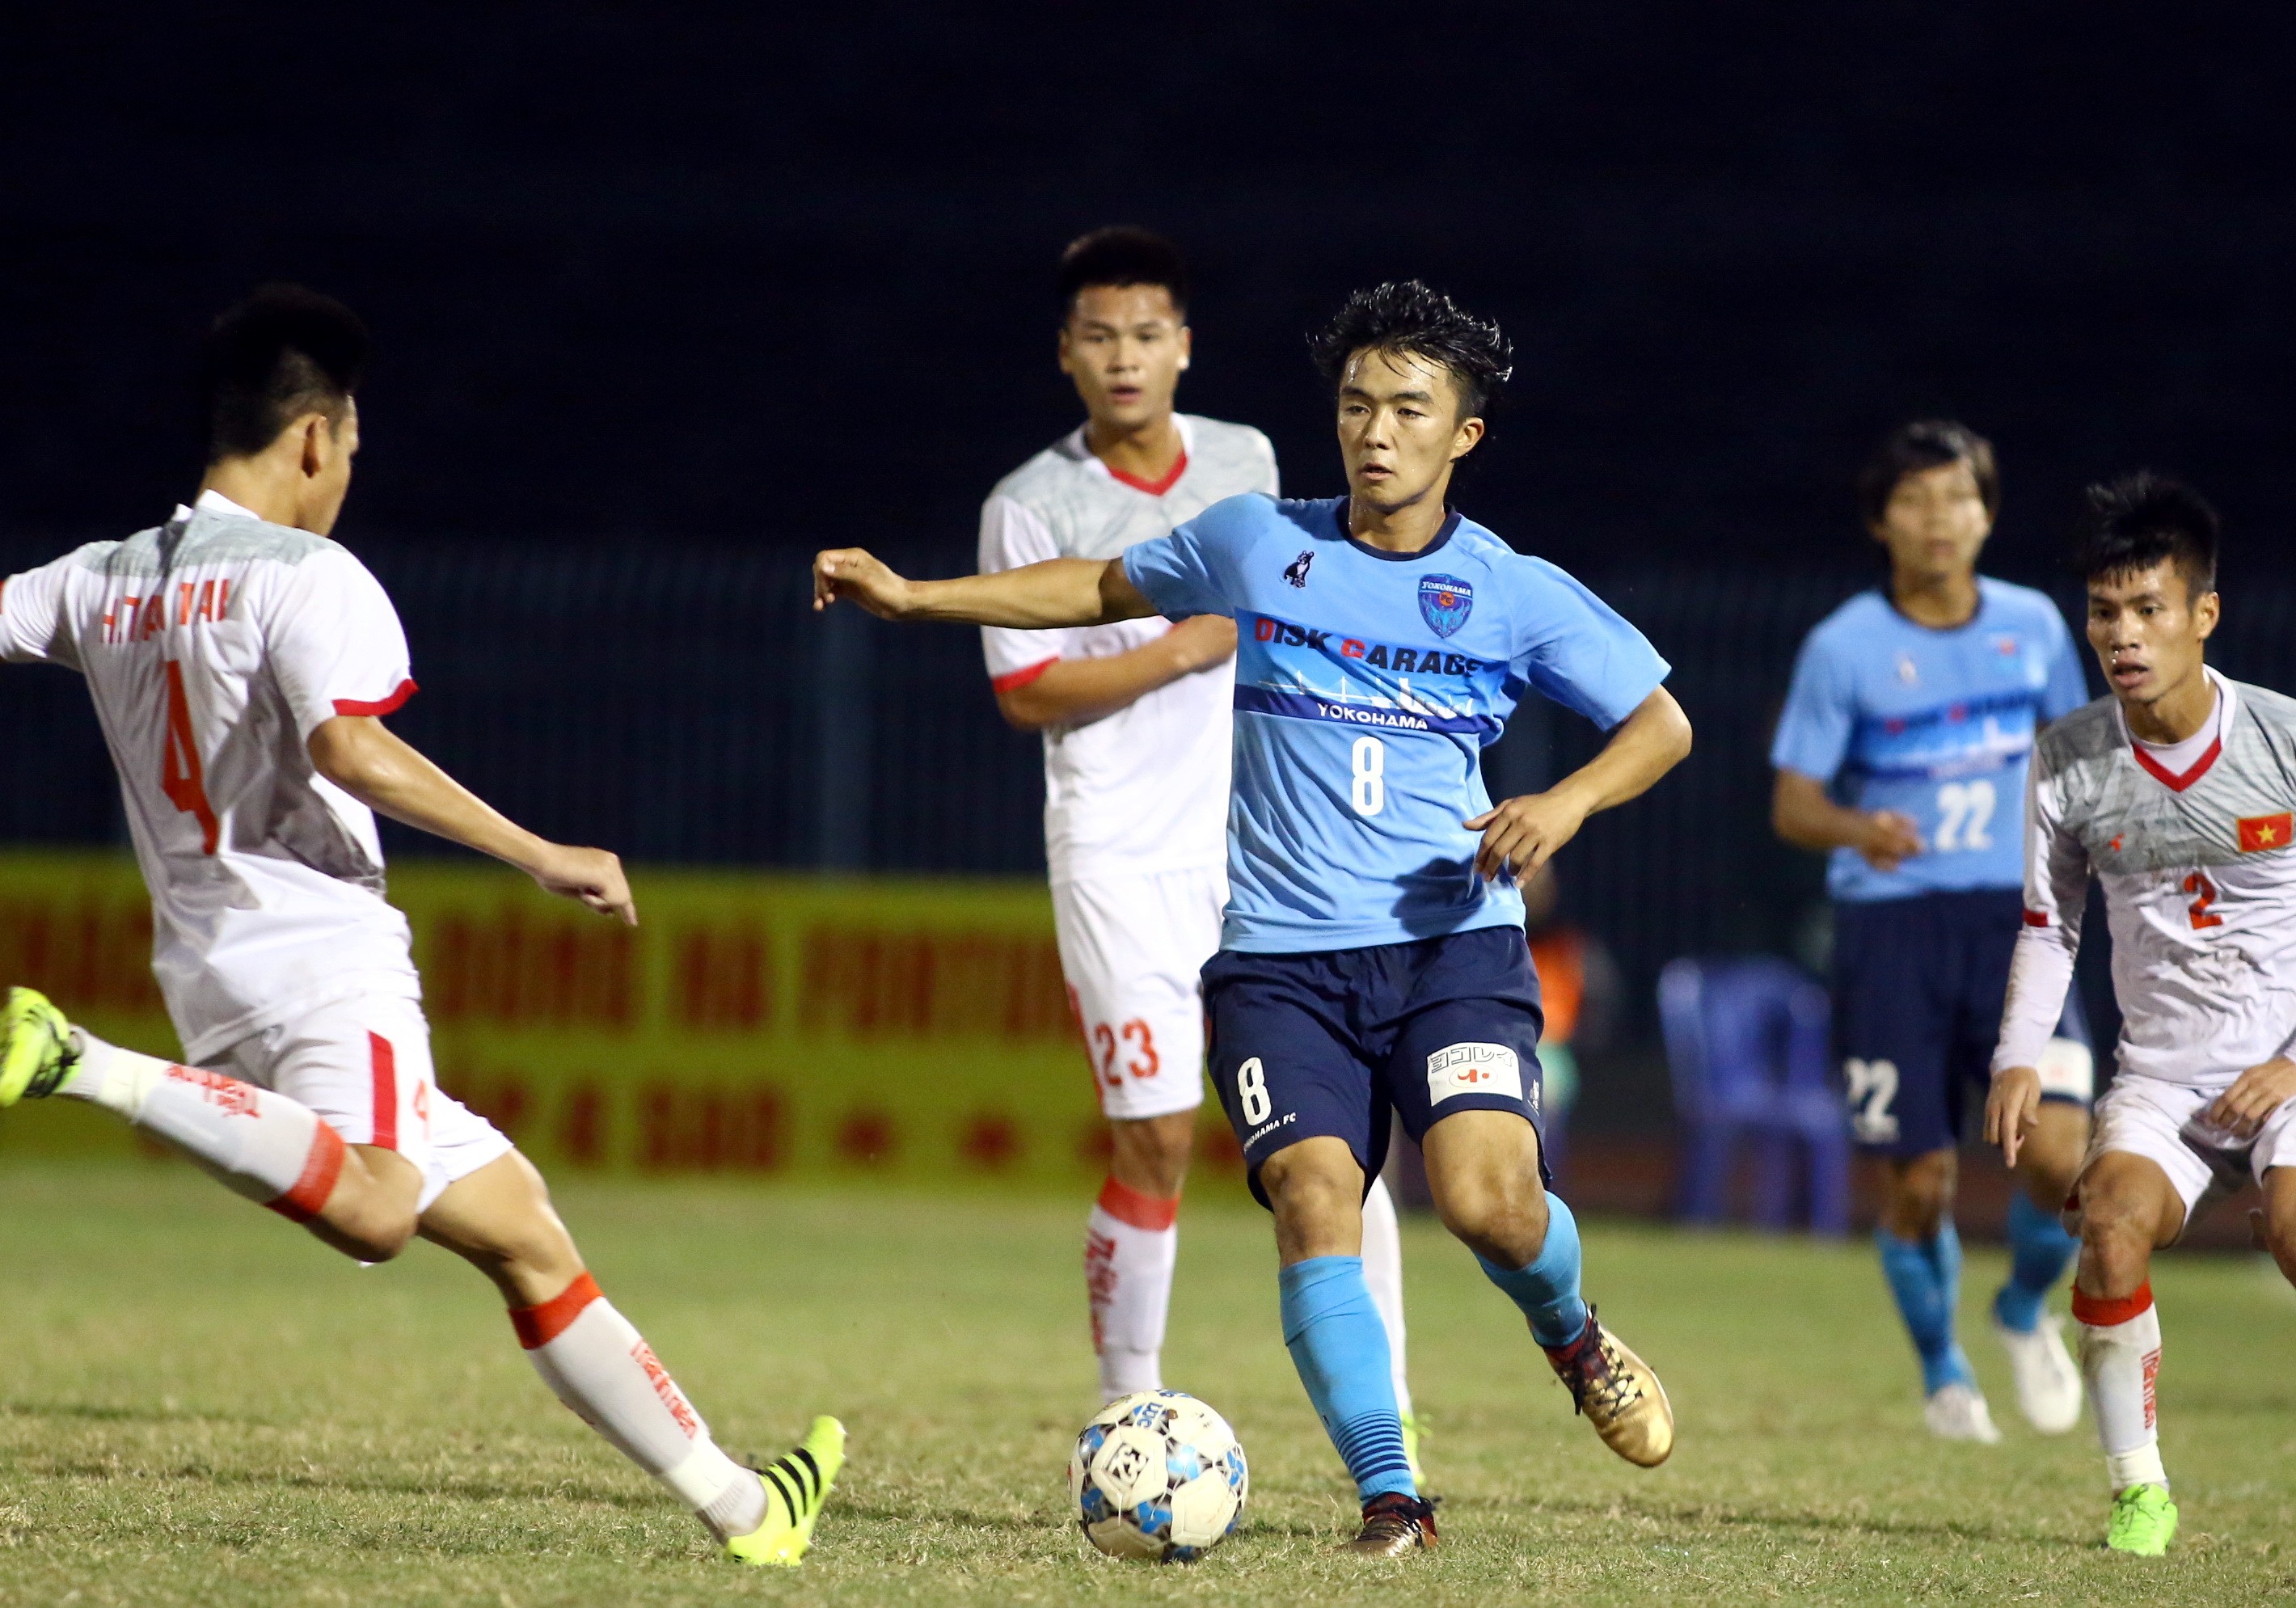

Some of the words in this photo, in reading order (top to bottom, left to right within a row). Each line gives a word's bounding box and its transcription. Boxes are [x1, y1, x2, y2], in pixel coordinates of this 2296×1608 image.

[1421, 581, 1471, 596] YOKOHAMA
[1255, 618, 1333, 651] DISK
[1317, 703, 1429, 730] YOKOHAMA
[161, 659, 219, 855] 4
[1352, 736, 1384, 816] 8
[1935, 779, 1996, 851] 22
[2184, 872, 2223, 930] 2
[1094, 1017, 1159, 1087] 23
[1430, 1046, 1514, 1074] ヨコレイ
[1236, 1056, 1272, 1126] 8
[1282, 1112, 1297, 1125] FC
